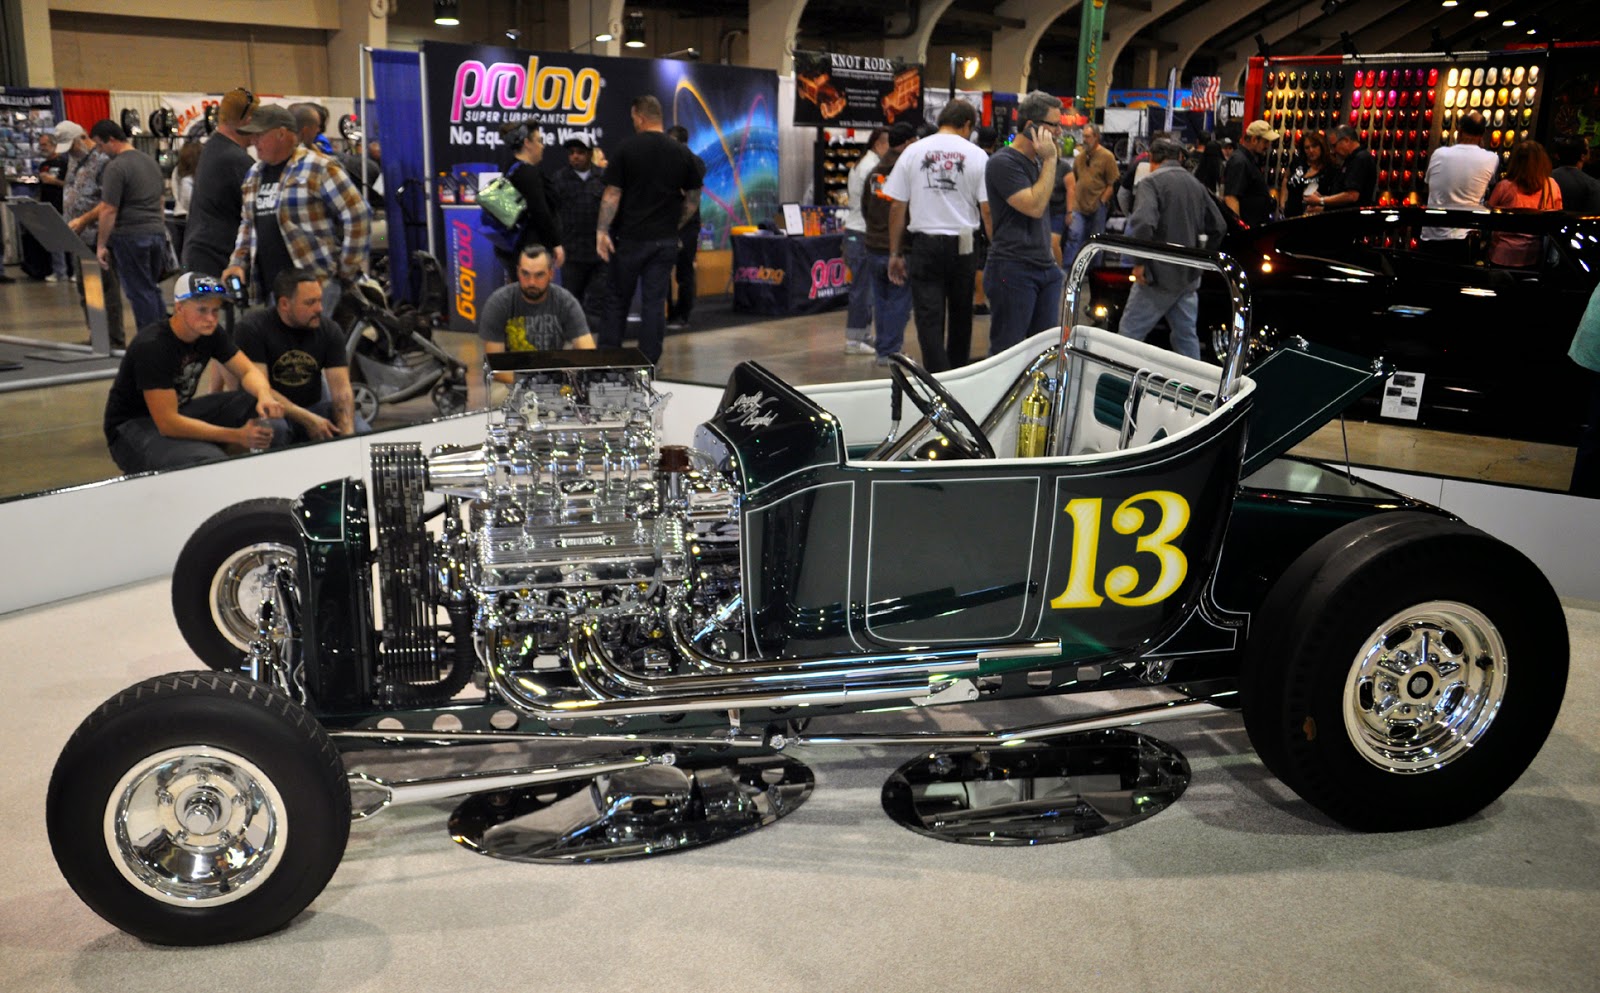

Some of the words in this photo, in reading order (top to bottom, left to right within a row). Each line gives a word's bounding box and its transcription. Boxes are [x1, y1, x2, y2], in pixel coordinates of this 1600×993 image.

[830, 53, 861, 69] KNOT
[864, 56, 894, 71] RODS
[450, 55, 600, 126] prolong
[464, 111, 500, 123] SUPER
[450, 126, 473, 145] No
[476, 126, 505, 150] Equ
[538, 126, 555, 145] he
[557, 128, 597, 146] Wld
[925, 152, 941, 162] CAR
[943, 151, 967, 161] SHOW
[453, 219, 477, 321] prolong
[735, 265, 785, 285] prolong
[1051, 490, 1191, 609] 13
